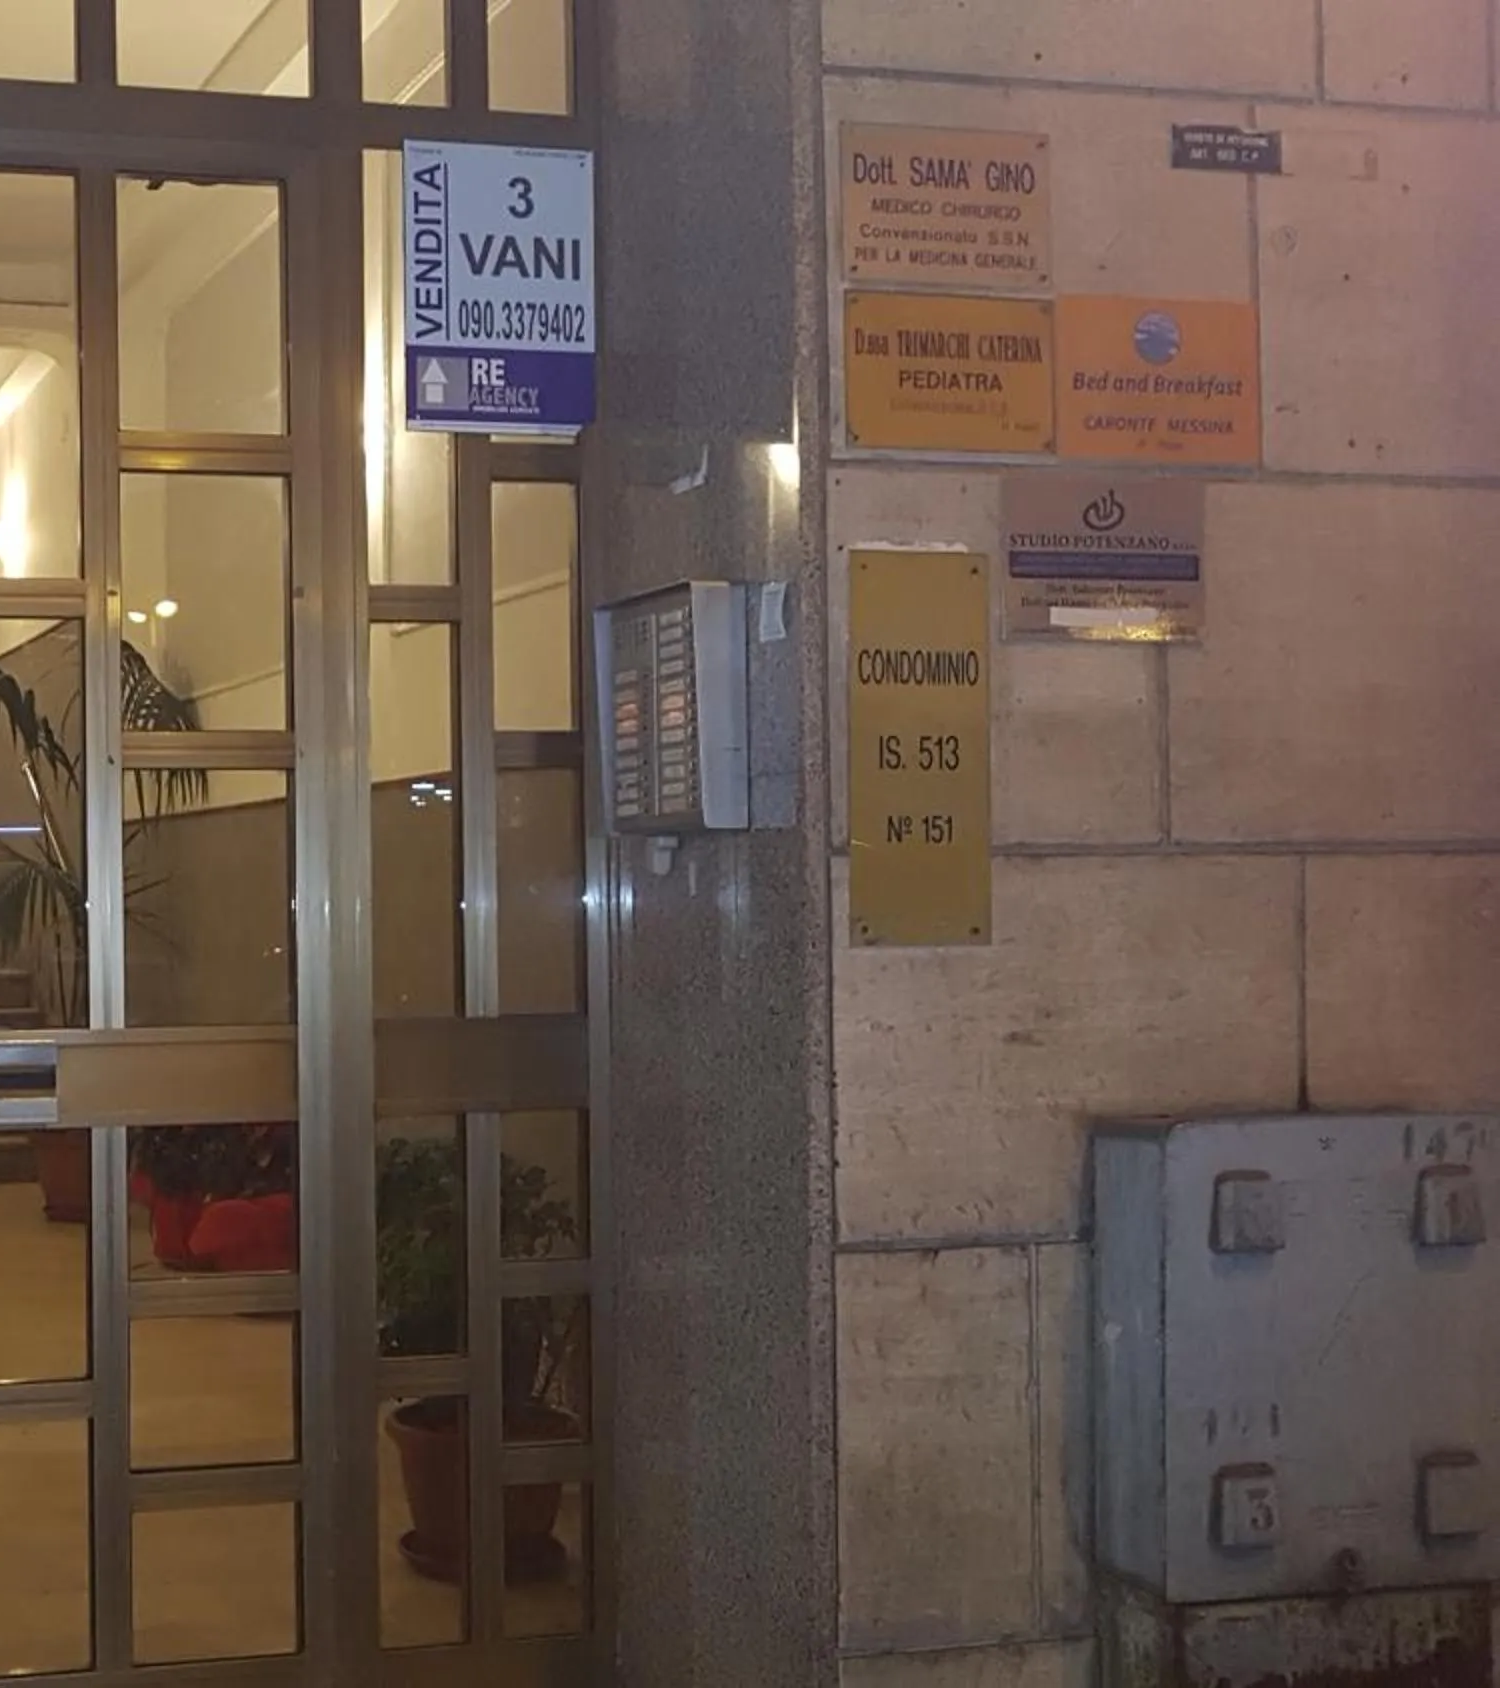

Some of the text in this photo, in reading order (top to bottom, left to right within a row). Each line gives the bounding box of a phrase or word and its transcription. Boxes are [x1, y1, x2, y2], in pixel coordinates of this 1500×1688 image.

[852, 153, 897, 186] Dott.
[985, 160, 1036, 195] GINO
[507, 176, 535, 219] 3
[871, 197, 1022, 221] MEDICO CHIRURGO
[413, 163, 444, 338] VENDITA
[458, 233, 581, 281] VANI
[854, 246, 1037, 270] PER LA MEDICINA GENERALE
[458, 300, 586, 343] 090.3379402
[978, 334, 1043, 363] CATERINA
[471, 358, 505, 386] RE
[899, 370, 1003, 392] PEDIATRA
[1073, 372, 1243, 400] Bed and Breakfast
[470, 386, 539, 407] AGENCY
[1084, 415, 1234, 434] CARONTE MESSINA
[1009, 533, 1069, 548] STUDIO
[1072, 535, 1170, 551] POTENZANO
[858, 649, 979, 686] CONDOMINIO
[879, 735, 960, 771] IS. 513
[921, 816, 954, 843] 151
[1245, 1487, 1274, 1531] 3
